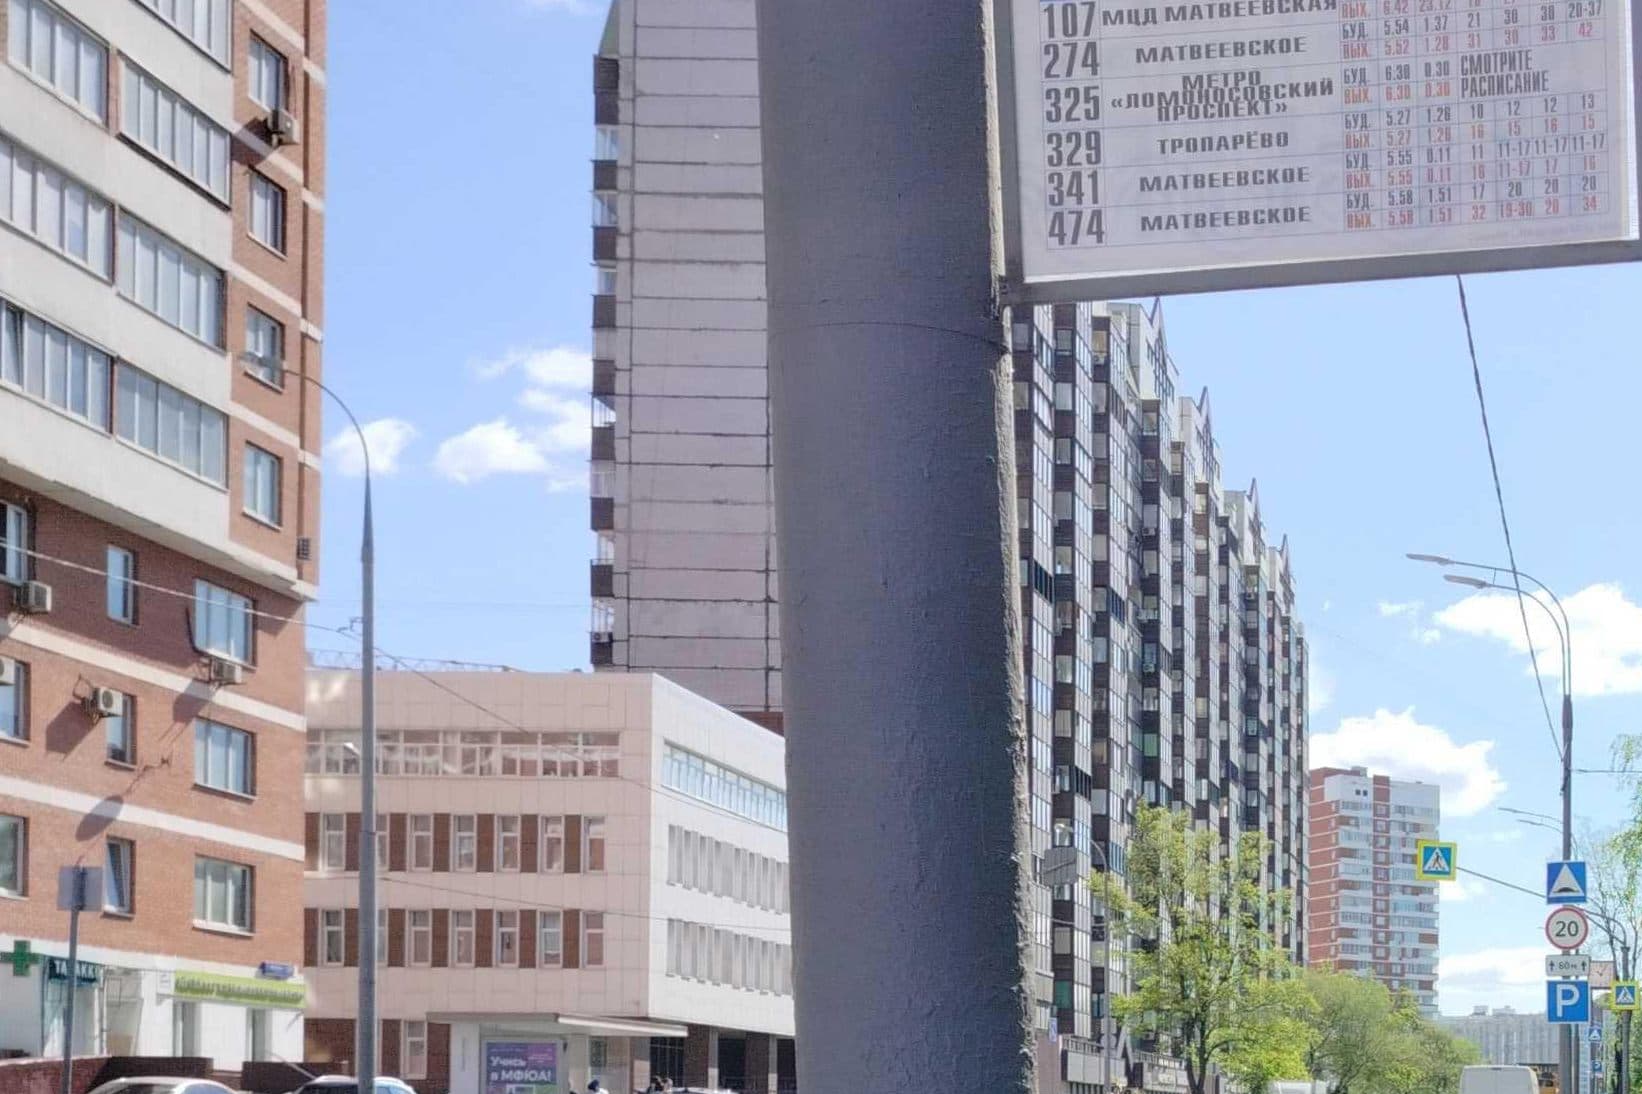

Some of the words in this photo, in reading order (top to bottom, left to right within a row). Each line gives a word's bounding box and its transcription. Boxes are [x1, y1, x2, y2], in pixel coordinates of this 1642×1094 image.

[1043, 1, 1095, 38] 107
[1102, 7, 1157, 26] МЦД
[1165, 0, 1337, 21] МАТВЕЕВСКАЯ
[1579, 22, 1592, 37] 42
[1043, 42, 1099, 78] 274
[1136, 37, 1307, 63] МАТВЕЕВСКОЕ
[1424, 15, 1448, 32] 1.37
[1467, 12, 1480, 28] 21
[1461, 50, 1533, 76] СМОТРИТЕ
[1111, 78, 1333, 108] «ЛОМОНОСОВСКИЙ
[1182, 71, 1261, 90] МЕТРО
[1461, 70, 1549, 99] РАСПИСАНИЕ
[1046, 86, 1100, 122] 325
[1157, 100, 1287, 122] ПРОСПЕКТ»
[1047, 130, 1101, 166] 329
[1157, 131, 1288, 155] ТРОПАРЁВО
[1386, 109, 1411, 126] 5.27
[1508, 101, 1520, 116] 12
[1544, 97, 1557, 112] 12
[1583, 94, 1594, 109] 13
[1049, 170, 1098, 206] 341
[1139, 167, 1311, 192] МАТВЕЕВСКОЕ
[1472, 144, 1483, 160] 11
[1499, 141, 1530, 158] 11-17
[1535, 137, 1567, 154] 11-17
[1573, 133, 1604, 152] 11-17
[1048, 210, 1104, 245] 474
[1140, 206, 1312, 231] МАТВЕЕВСКОЕ
[1473, 183, 1485, 200] 17
[1555, 920, 1579, 937] 20
[1556, 984, 1579, 1017] P
[501, 1069, 551, 1081] МФЮА!
